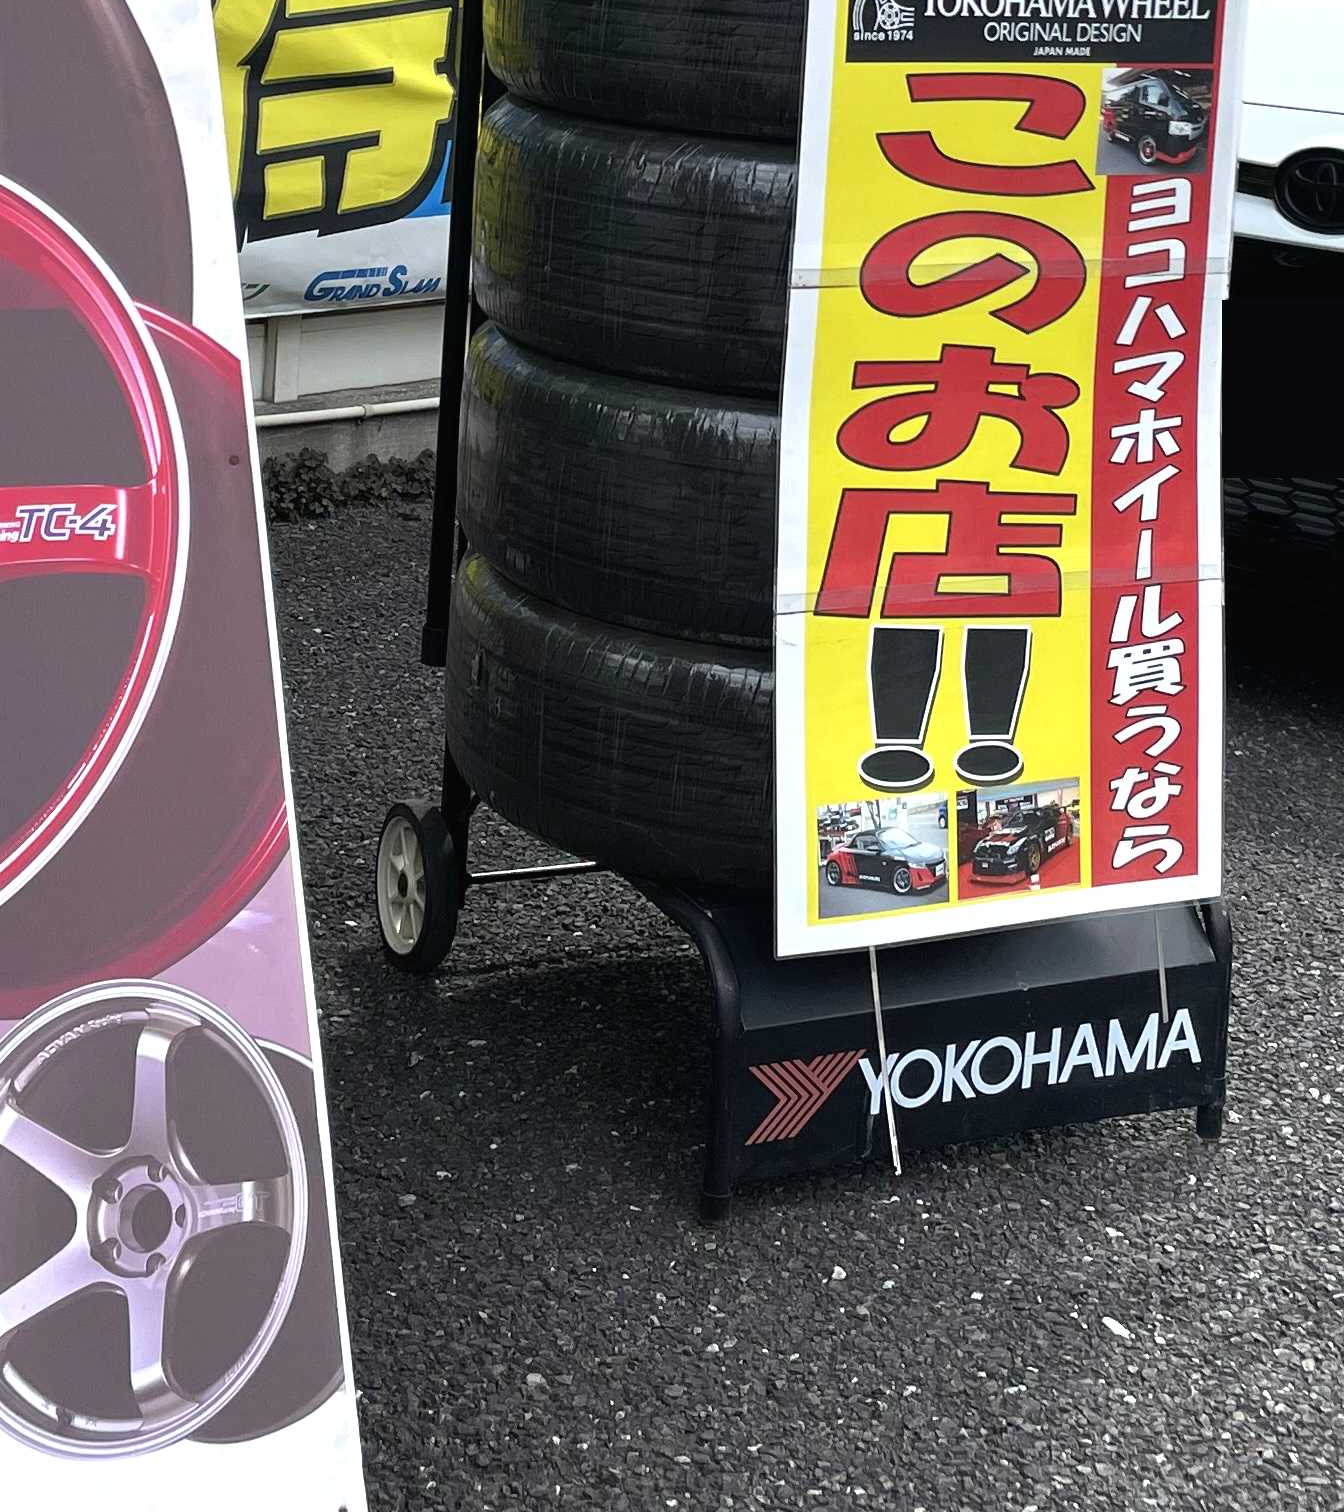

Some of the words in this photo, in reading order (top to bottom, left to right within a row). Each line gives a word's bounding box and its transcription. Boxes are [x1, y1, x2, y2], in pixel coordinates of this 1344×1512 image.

[853, 29, 886, 41] since
[887, 29, 914, 41] 1974
[983, 21, 1072, 43] ORIGINAL
[1076, 22, 1143, 43] DESIGN
[1033, 46, 1063, 57] JAPAN
[1065, 46, 1091, 57] MADE
[15, 503, 119, 543] TC-4
[1105, 177, 1193, 874] ヨコハマホイール買うなら
[857, 1007, 1202, 1116] YOKOHAMA
